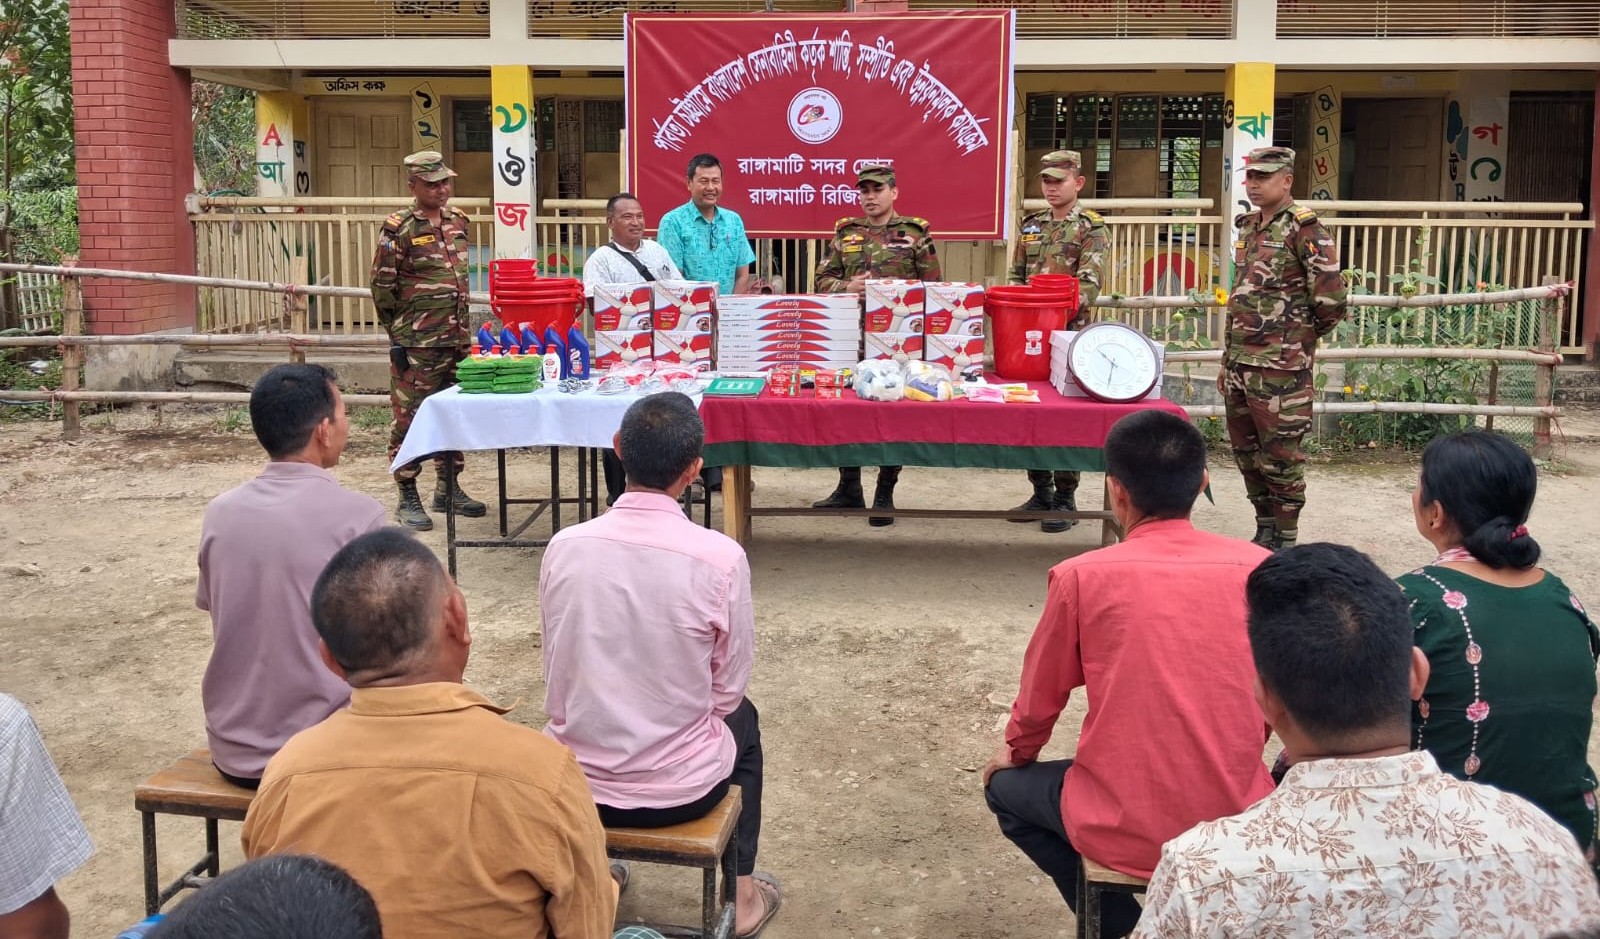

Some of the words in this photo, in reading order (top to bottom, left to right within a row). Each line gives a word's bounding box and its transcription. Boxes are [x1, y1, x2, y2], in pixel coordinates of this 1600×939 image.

[701, 53, 752, 103] বাংলাদেশ
[748, 29, 798, 82] সেনাবাহিনী
[798, 26, 828, 85] কর্তৃক
[856, 35, 895, 83] সম্প্রীতি
[889, 58, 916, 96] এবং
[324, 77, 359, 92] অফিস
[362, 80, 387, 92] কক্ষ
[415, 90, 432, 109] ১
[262, 122, 284, 147] A
[418, 120, 439, 139] ২
[1235, 111, 1272, 140] ঝ
[1471, 122, 1504, 146] গ
[256, 160, 286, 184] আ
[736, 153, 805, 175] রাঙ্গামাটি
[809, 158, 848, 175] সদর
[747, 184, 816, 206] রাঙ্গামাটি
[820, 184, 862, 206] রিজি
[495, 203, 531, 231] জ
[775, 300, 800, 309] Lovely
[775, 320, 800, 329] Lovely
[776, 341, 801, 350] Lovely
[777, 331, 802, 340] Lovely
[775, 351, 800, 360] Lovely
